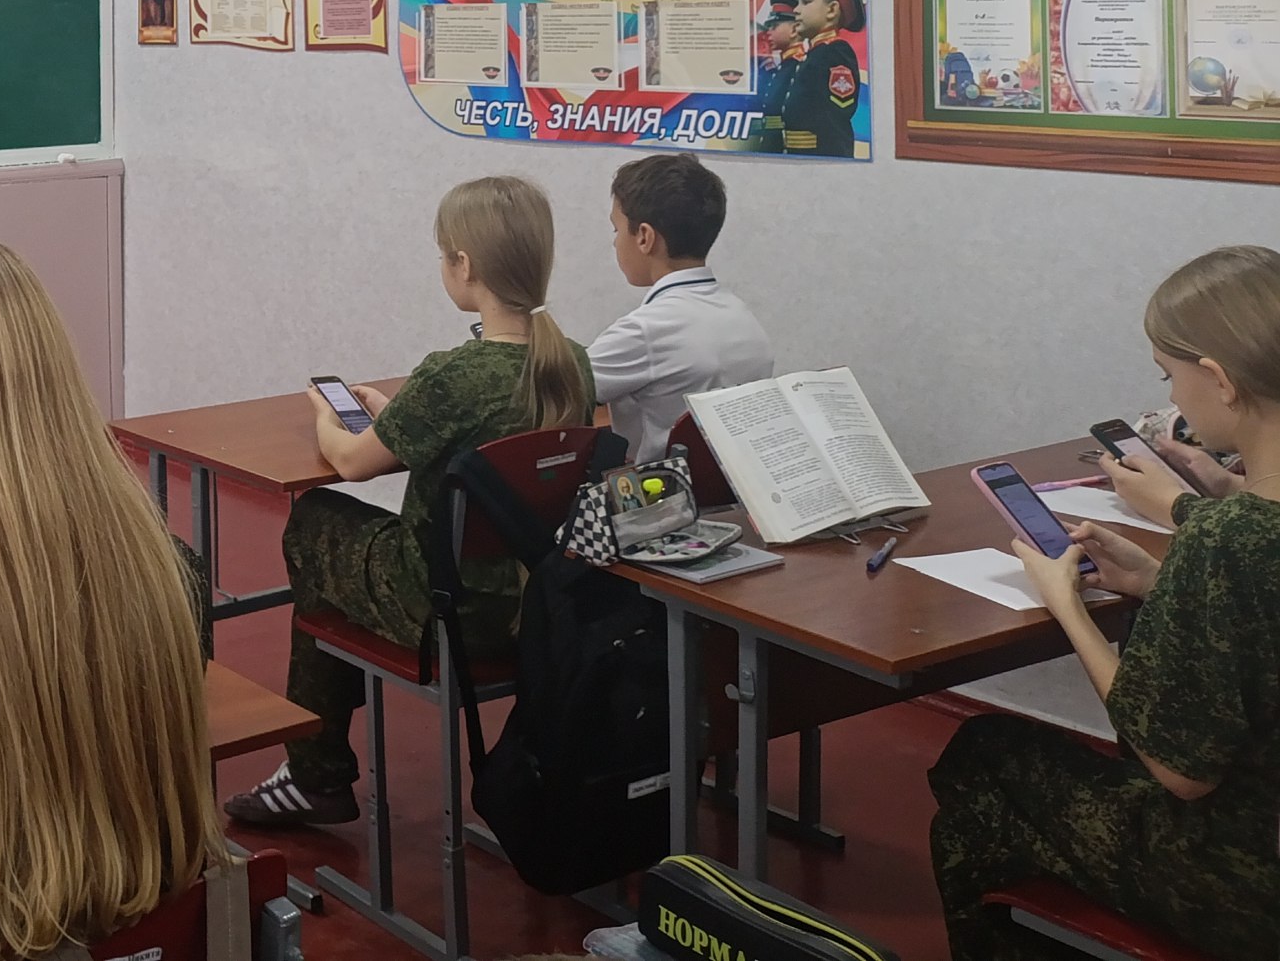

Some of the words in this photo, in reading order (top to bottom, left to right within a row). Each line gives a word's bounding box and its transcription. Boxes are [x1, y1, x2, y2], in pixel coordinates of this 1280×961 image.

[454, 98, 539, 134] ЧЕСТЬ,
[546, 103, 666, 140] ЗНАНИЯ,
[672, 108, 763, 142] ДОЛГ
